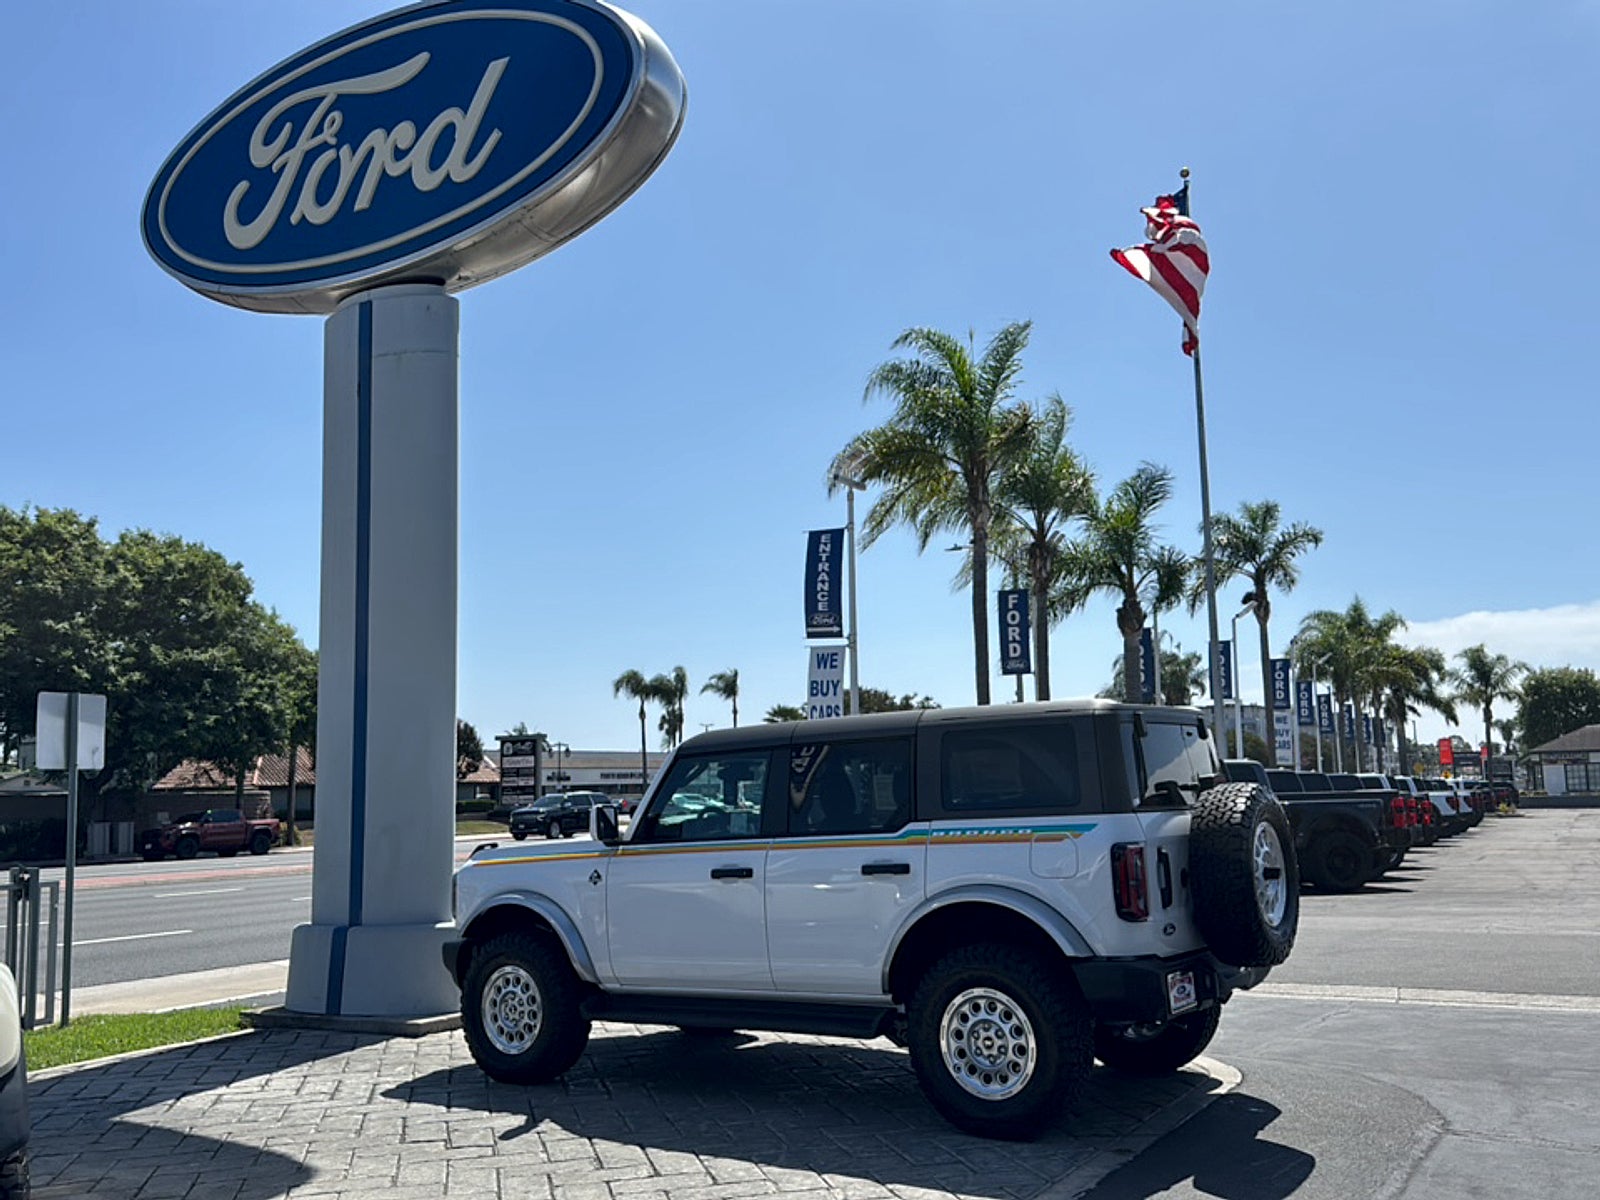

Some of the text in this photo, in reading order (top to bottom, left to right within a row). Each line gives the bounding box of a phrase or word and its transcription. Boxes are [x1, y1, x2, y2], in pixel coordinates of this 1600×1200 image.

[223, 51, 510, 249] Ford
[816, 533, 832, 612] ENTRANCE
[1006, 594, 1021, 658] FORD
[816, 652, 839, 670] WE
[1274, 661, 1285, 700] FORD
[810, 680, 840, 698] BUY
[1300, 683, 1309, 716] FORD
